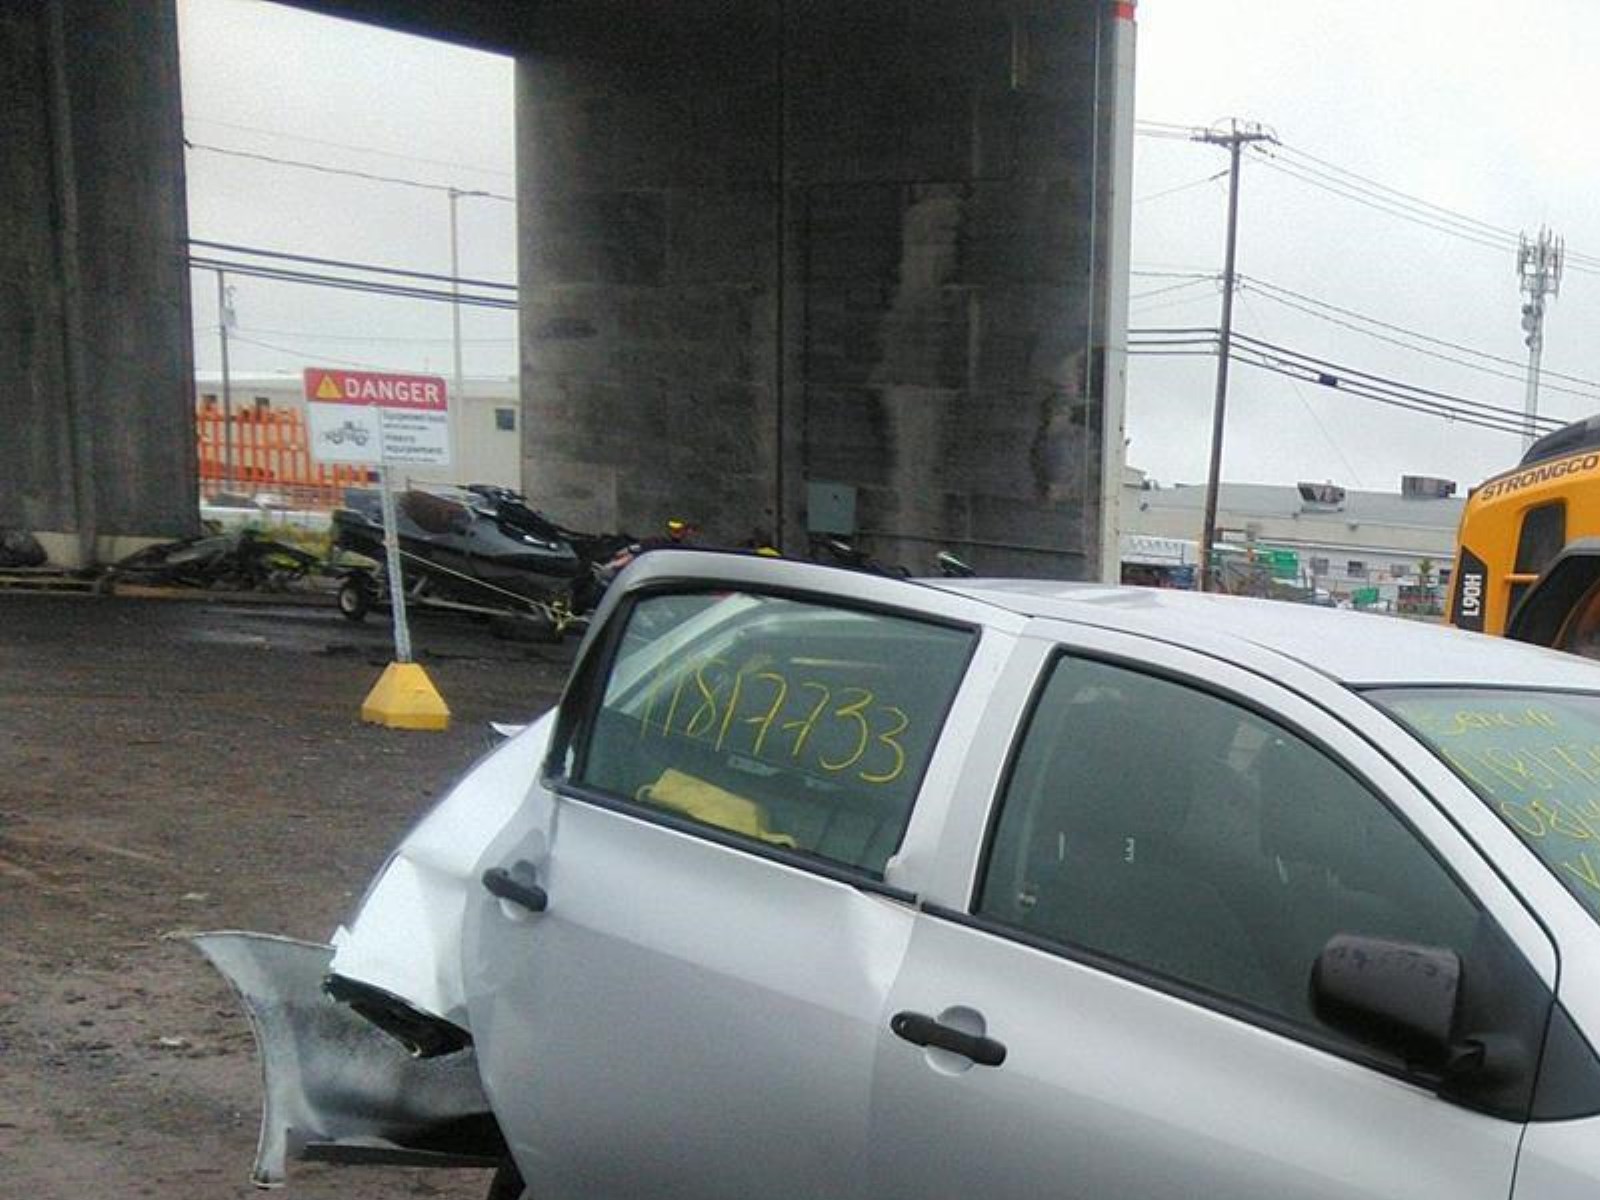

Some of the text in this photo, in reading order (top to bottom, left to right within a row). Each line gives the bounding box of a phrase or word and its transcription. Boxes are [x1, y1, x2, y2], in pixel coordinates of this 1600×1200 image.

[344, 378, 440, 402] DANGER
[1480, 454, 1600, 500] STRONGCO
[1462, 573, 1482, 616] L90H
